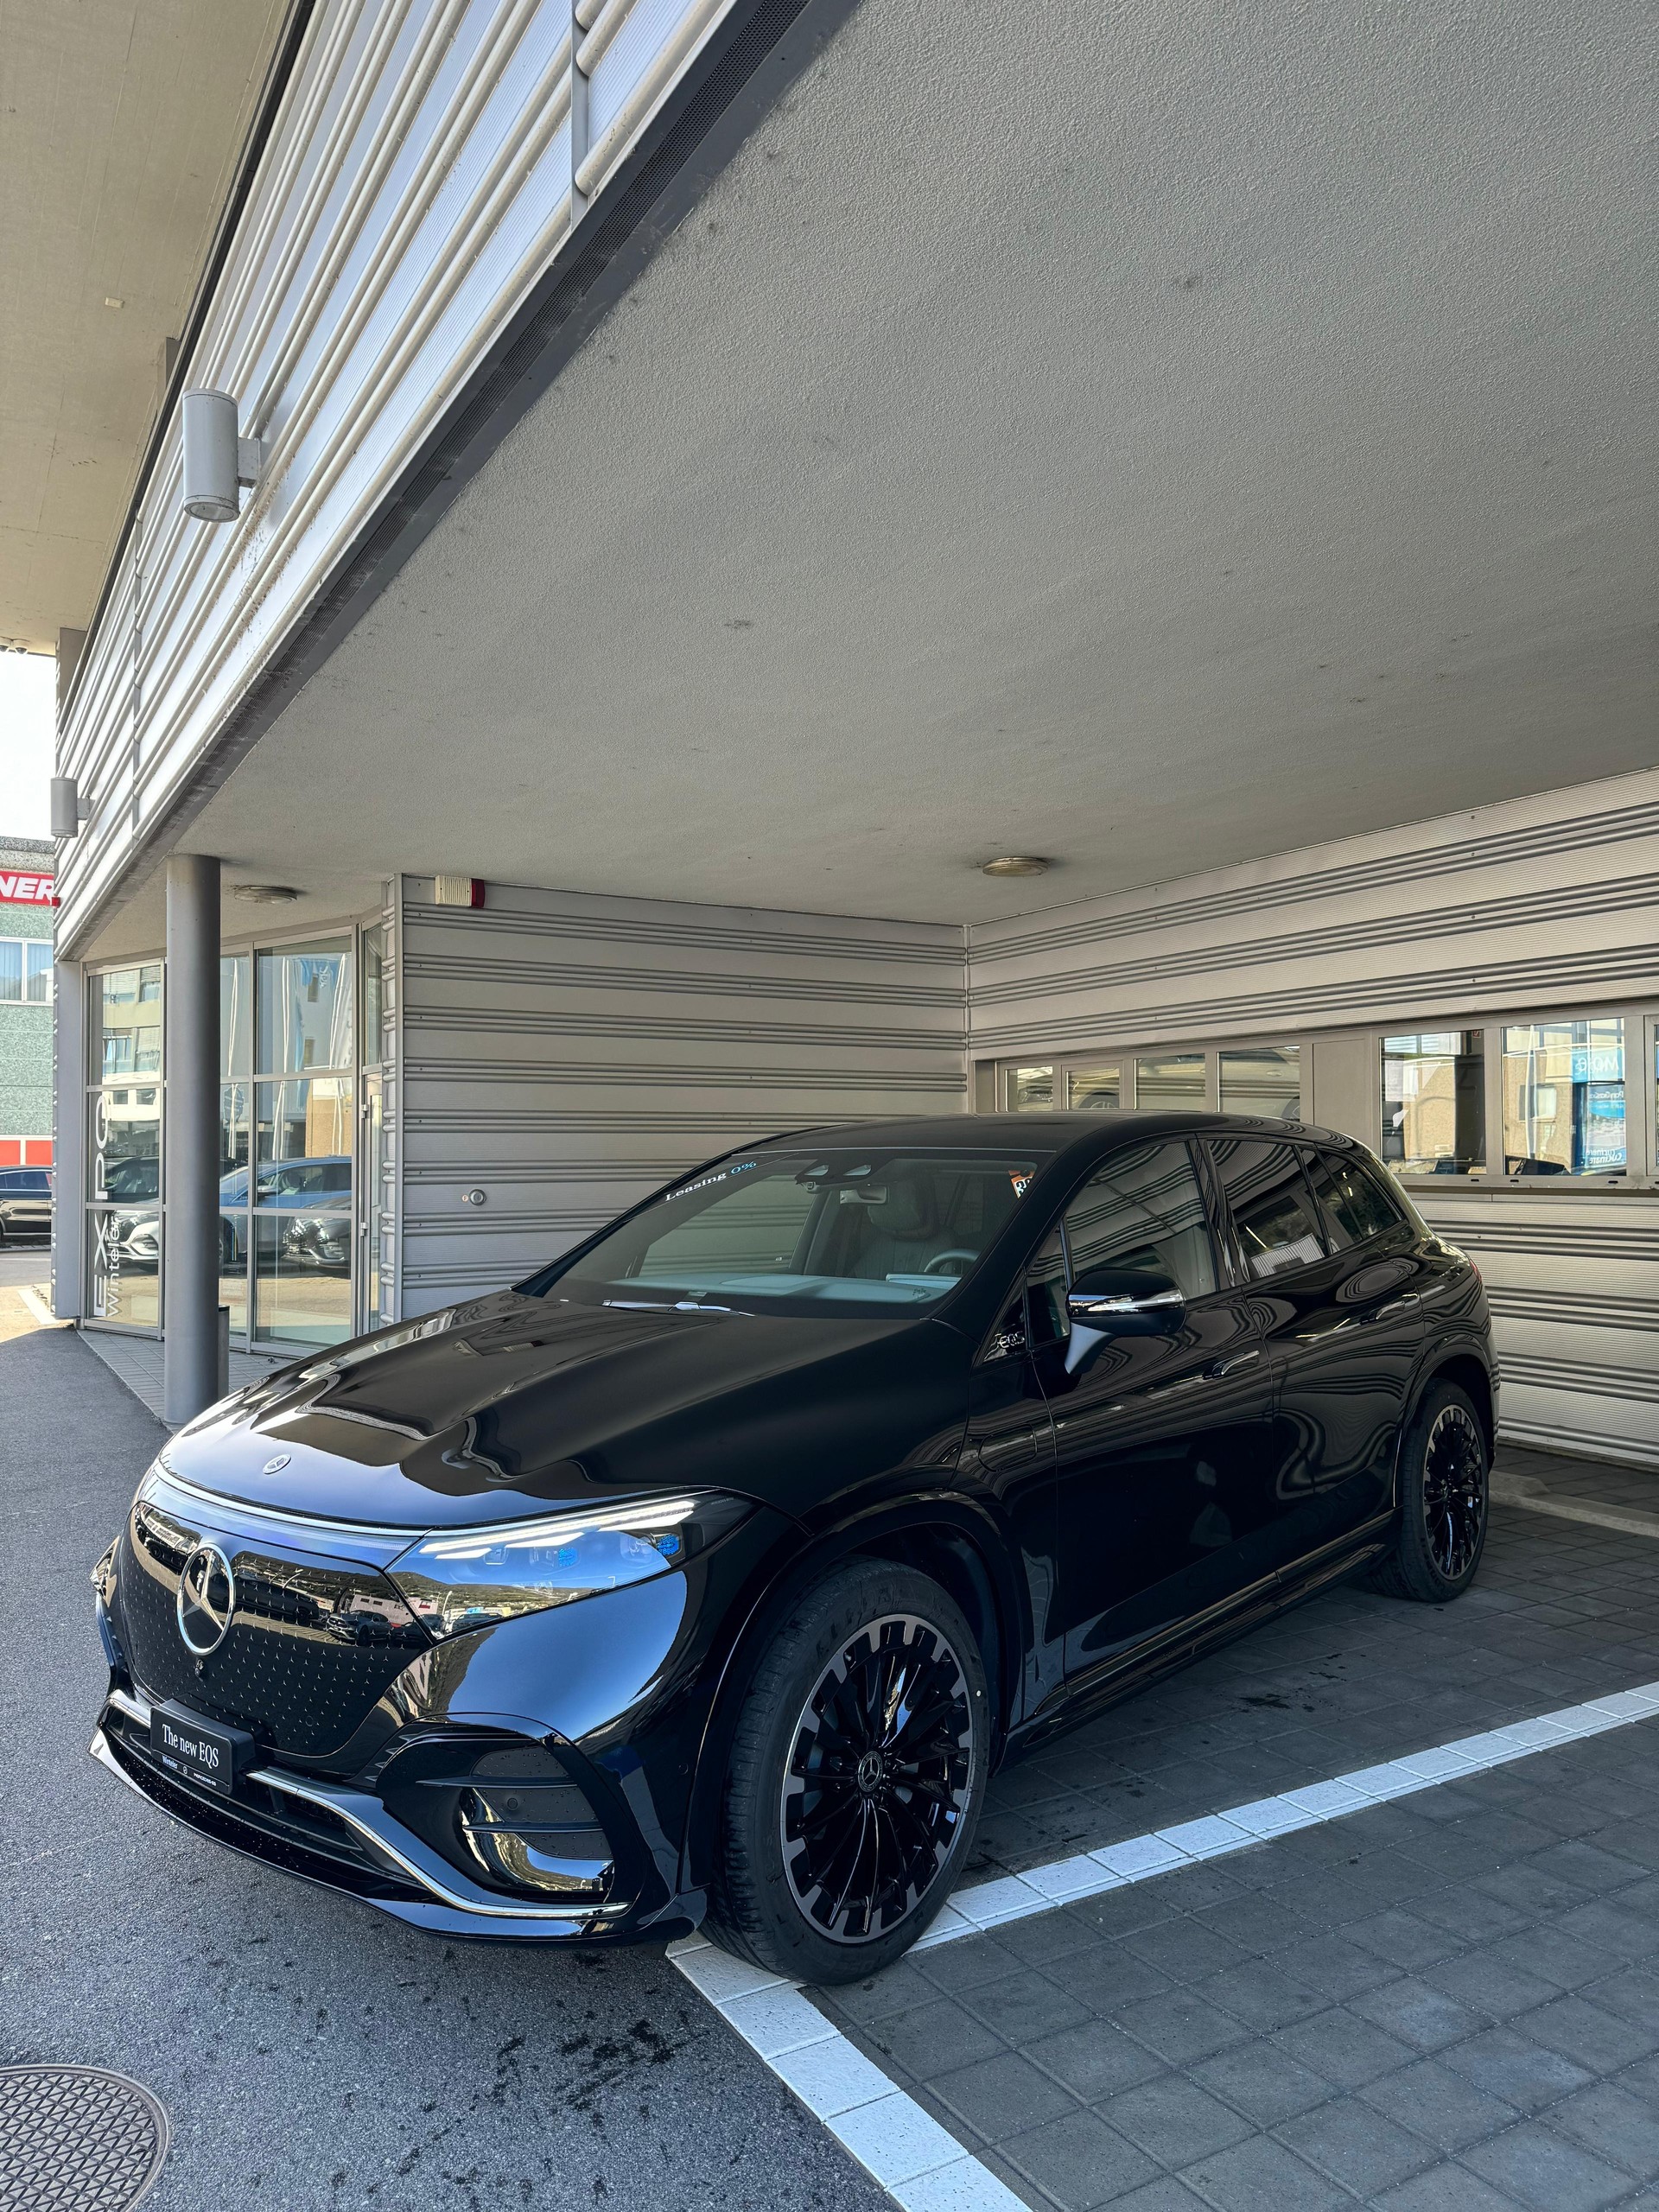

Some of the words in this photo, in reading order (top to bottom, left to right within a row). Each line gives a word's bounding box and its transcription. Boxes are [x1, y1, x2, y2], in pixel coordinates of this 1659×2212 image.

[94, 1095, 109, 1317] EXPO
[665, 1173, 727, 1201] Leasing
[731, 1161, 757, 1174] 0%
[107, 1214, 120, 1318] Winteler
[162, 1723, 178, 1749] The
[179, 1737, 198, 1758] new
[199, 1741, 219, 1770] EQS
